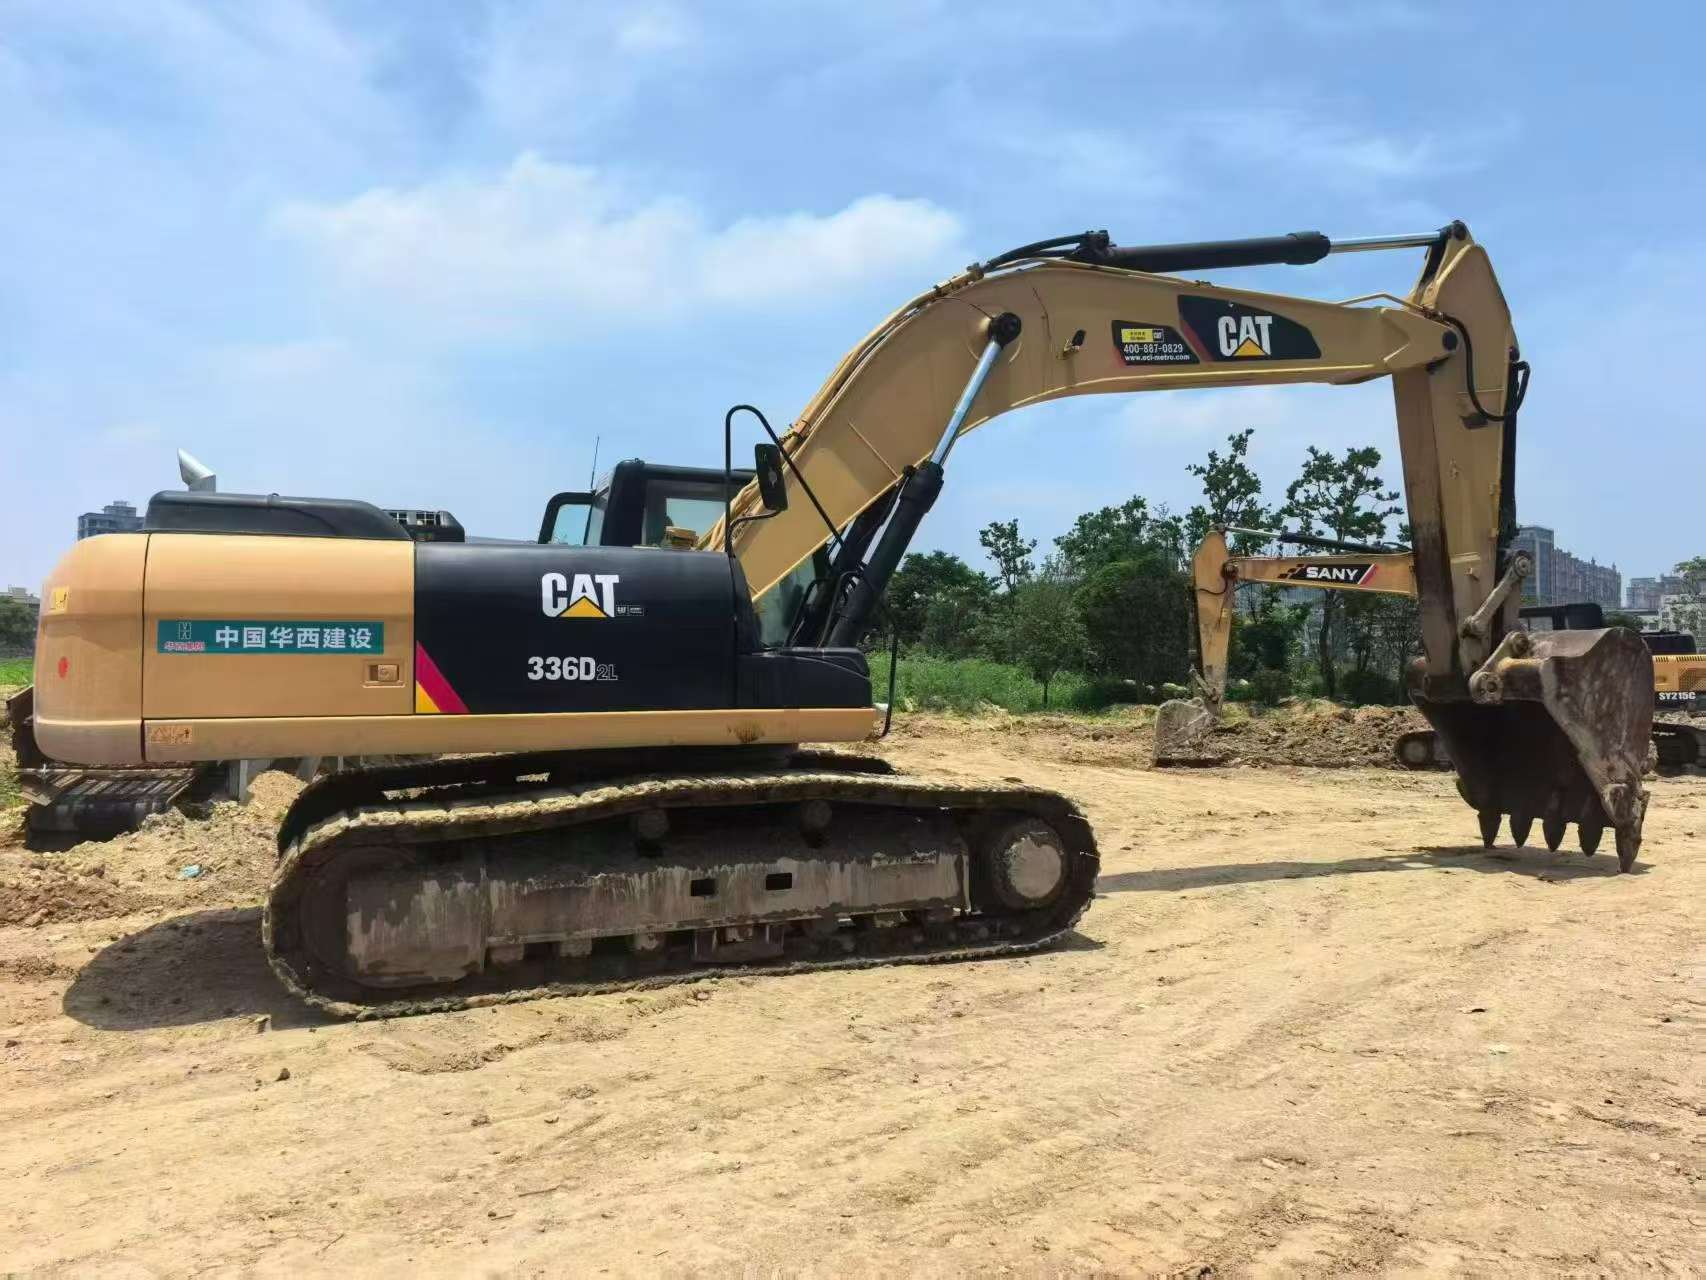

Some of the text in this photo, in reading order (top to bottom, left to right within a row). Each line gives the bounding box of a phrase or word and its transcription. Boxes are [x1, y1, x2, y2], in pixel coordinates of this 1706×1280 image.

[1218, 315, 1272, 356] CAT
[1306, 566, 1358, 580] SANY
[541, 572, 619, 617] CAT
[215, 625, 372, 649] 中国华西建设
[1658, 691, 1696, 700] SY215C
